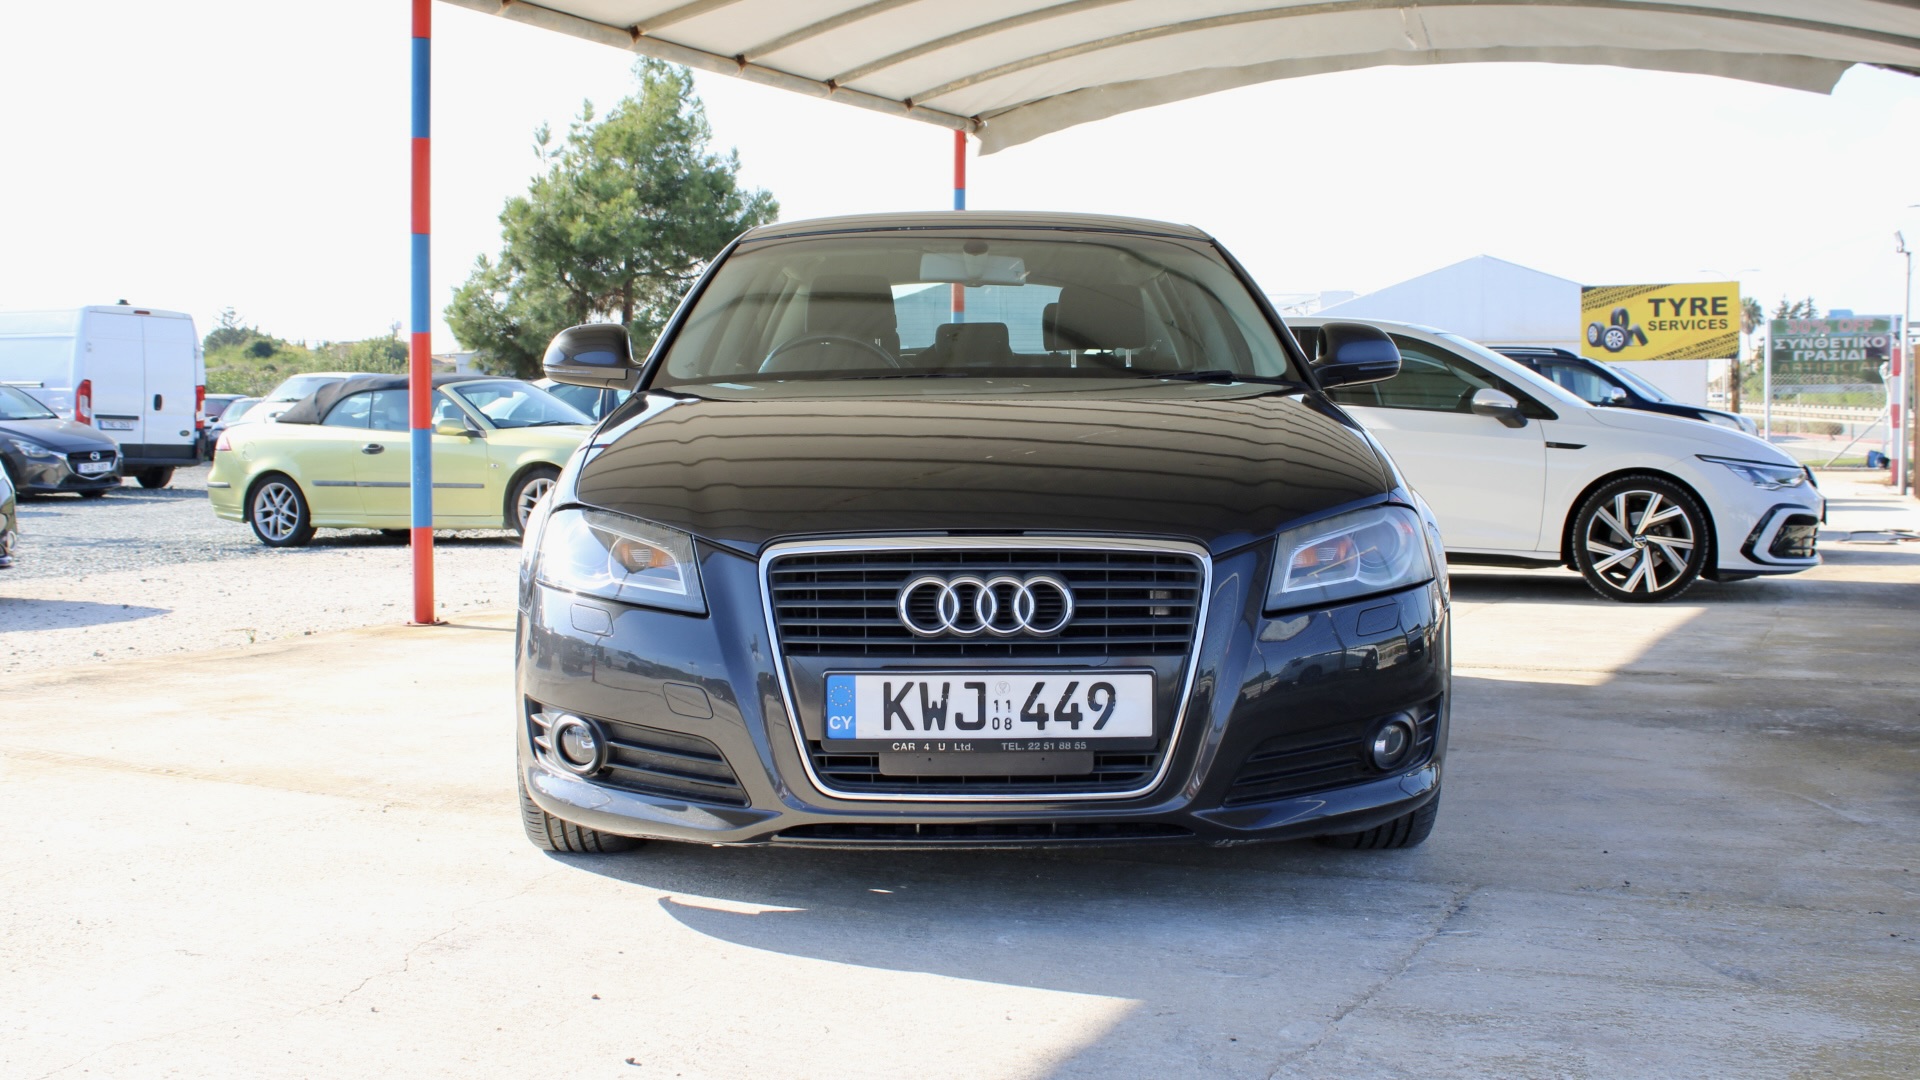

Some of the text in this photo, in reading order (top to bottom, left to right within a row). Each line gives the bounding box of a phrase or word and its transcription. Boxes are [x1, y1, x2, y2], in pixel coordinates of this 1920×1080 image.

[1648, 296, 1728, 317] TYRE
[1648, 319, 1728, 331] SERVICES
[1786, 318, 1873, 334] 30% OFF
[1774, 337, 1886, 350] ΣΥΝΘΕΤΙΚΟ
[1793, 350, 1867, 361] ΓΡΑΣΙΔΙ
[883, 681, 1116, 730] KWJ 449
[993, 699, 1011, 713] 11
[829, 716, 852, 730] CY
[992, 717, 1012, 730] 08
[892, 742, 974, 751] CAR 4 U Ltd.
[1001, 741, 1087, 751] TEL. 22 51 88 55
